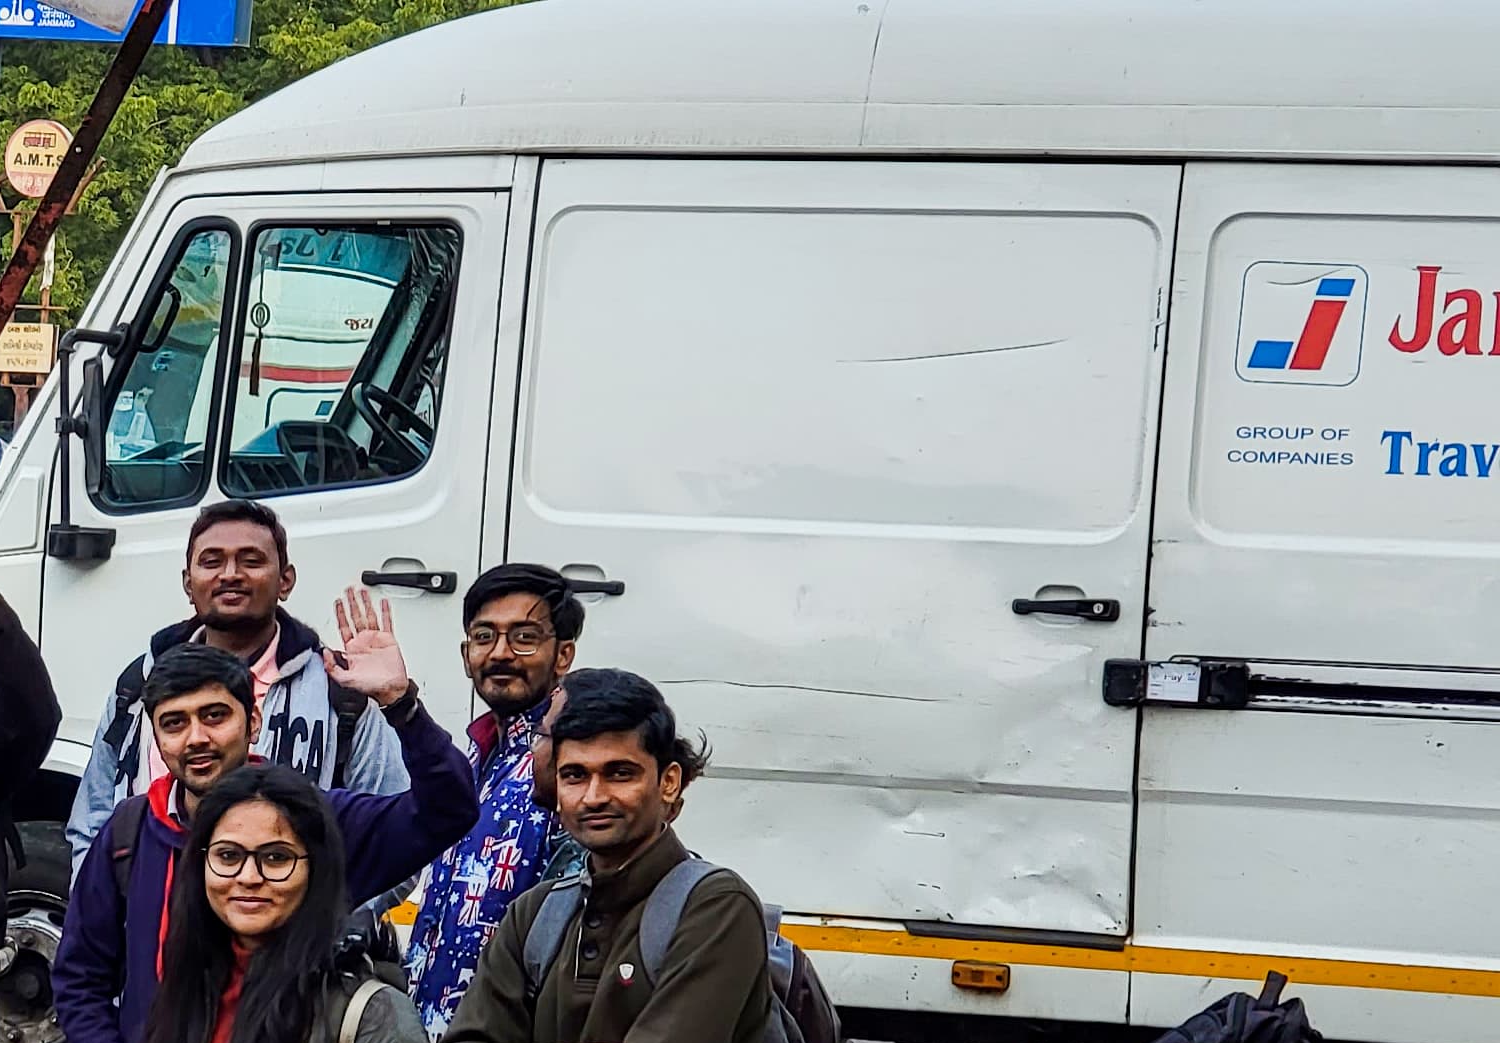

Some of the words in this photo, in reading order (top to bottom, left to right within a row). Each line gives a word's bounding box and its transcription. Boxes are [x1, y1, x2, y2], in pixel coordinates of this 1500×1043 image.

[1235, 426, 1314, 441] GROUP
[1320, 427, 1351, 442] OF
[1227, 449, 1354, 466] COMPANIES
[1380, 430, 1500, 478] Trav
